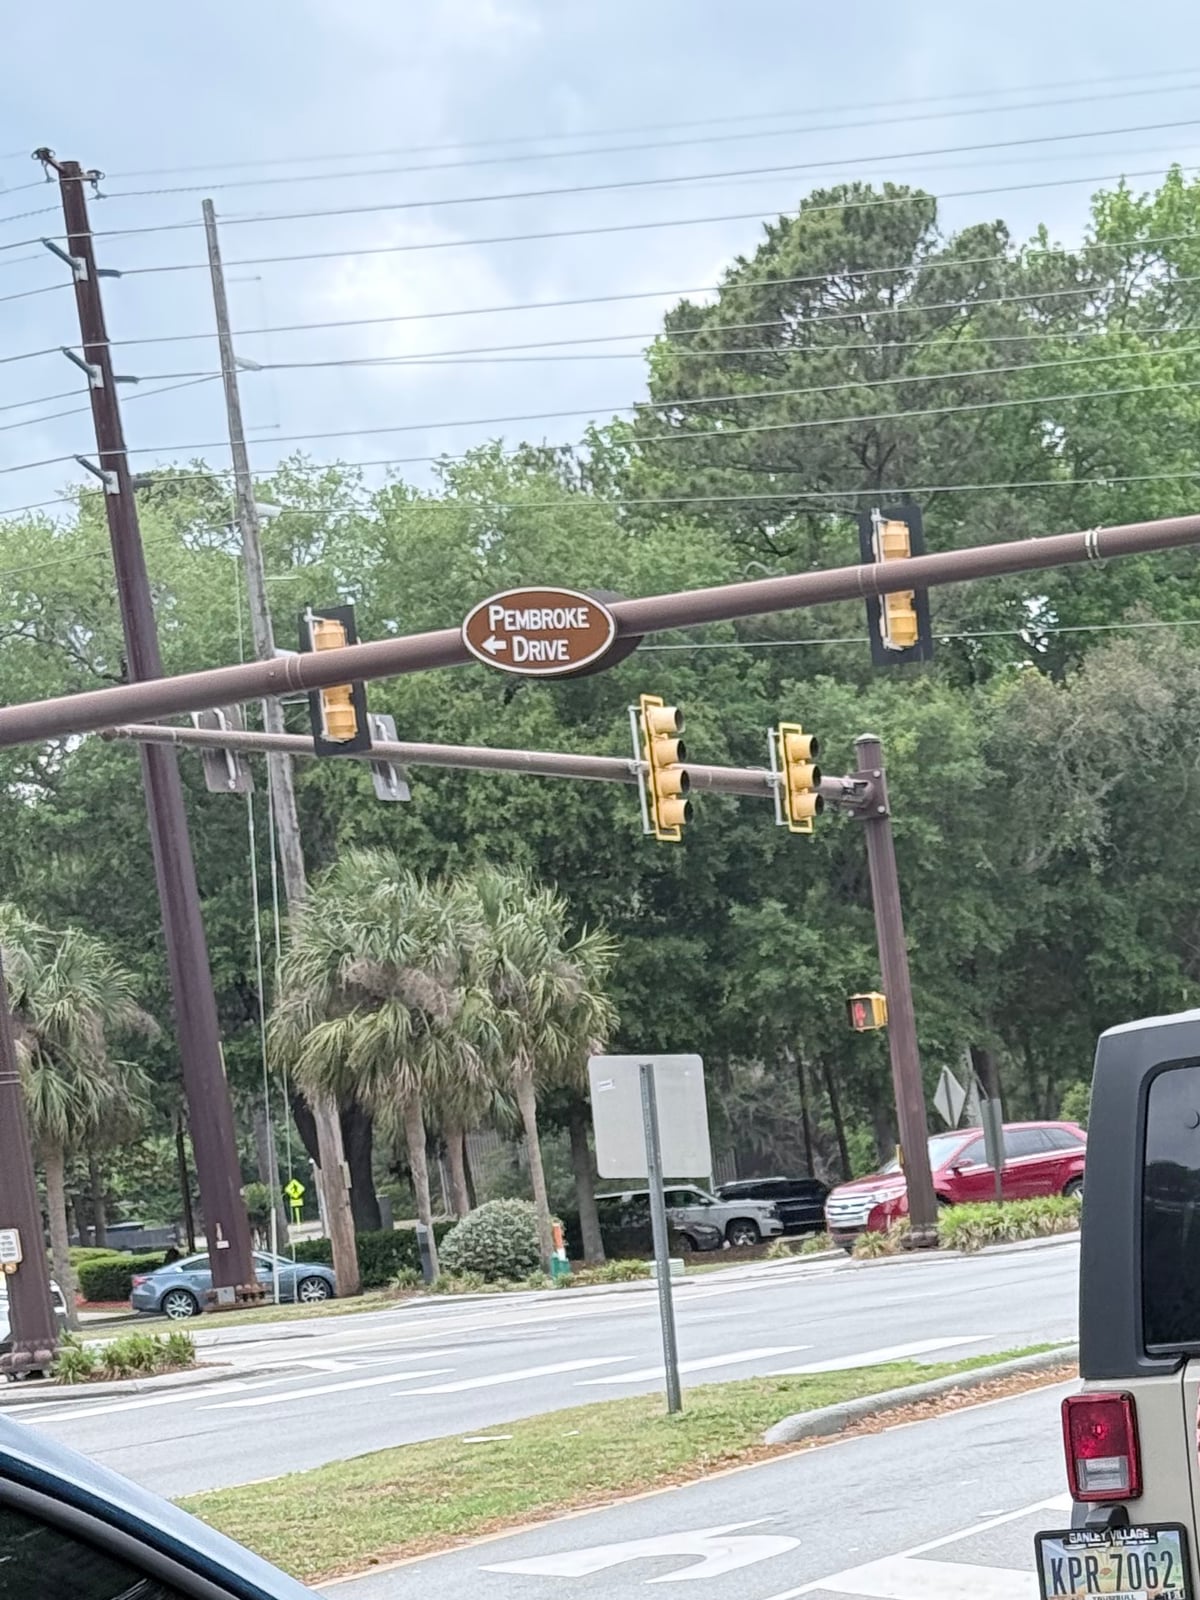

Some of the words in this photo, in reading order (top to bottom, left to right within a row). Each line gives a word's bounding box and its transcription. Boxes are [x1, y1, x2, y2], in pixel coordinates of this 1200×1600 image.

[488, 605, 590, 632] PEMBROKE
[512, 635, 570, 662] DRIVE
[1051, 1555, 1101, 1596] KPR
[1109, 1551, 1177, 1593] 7062
